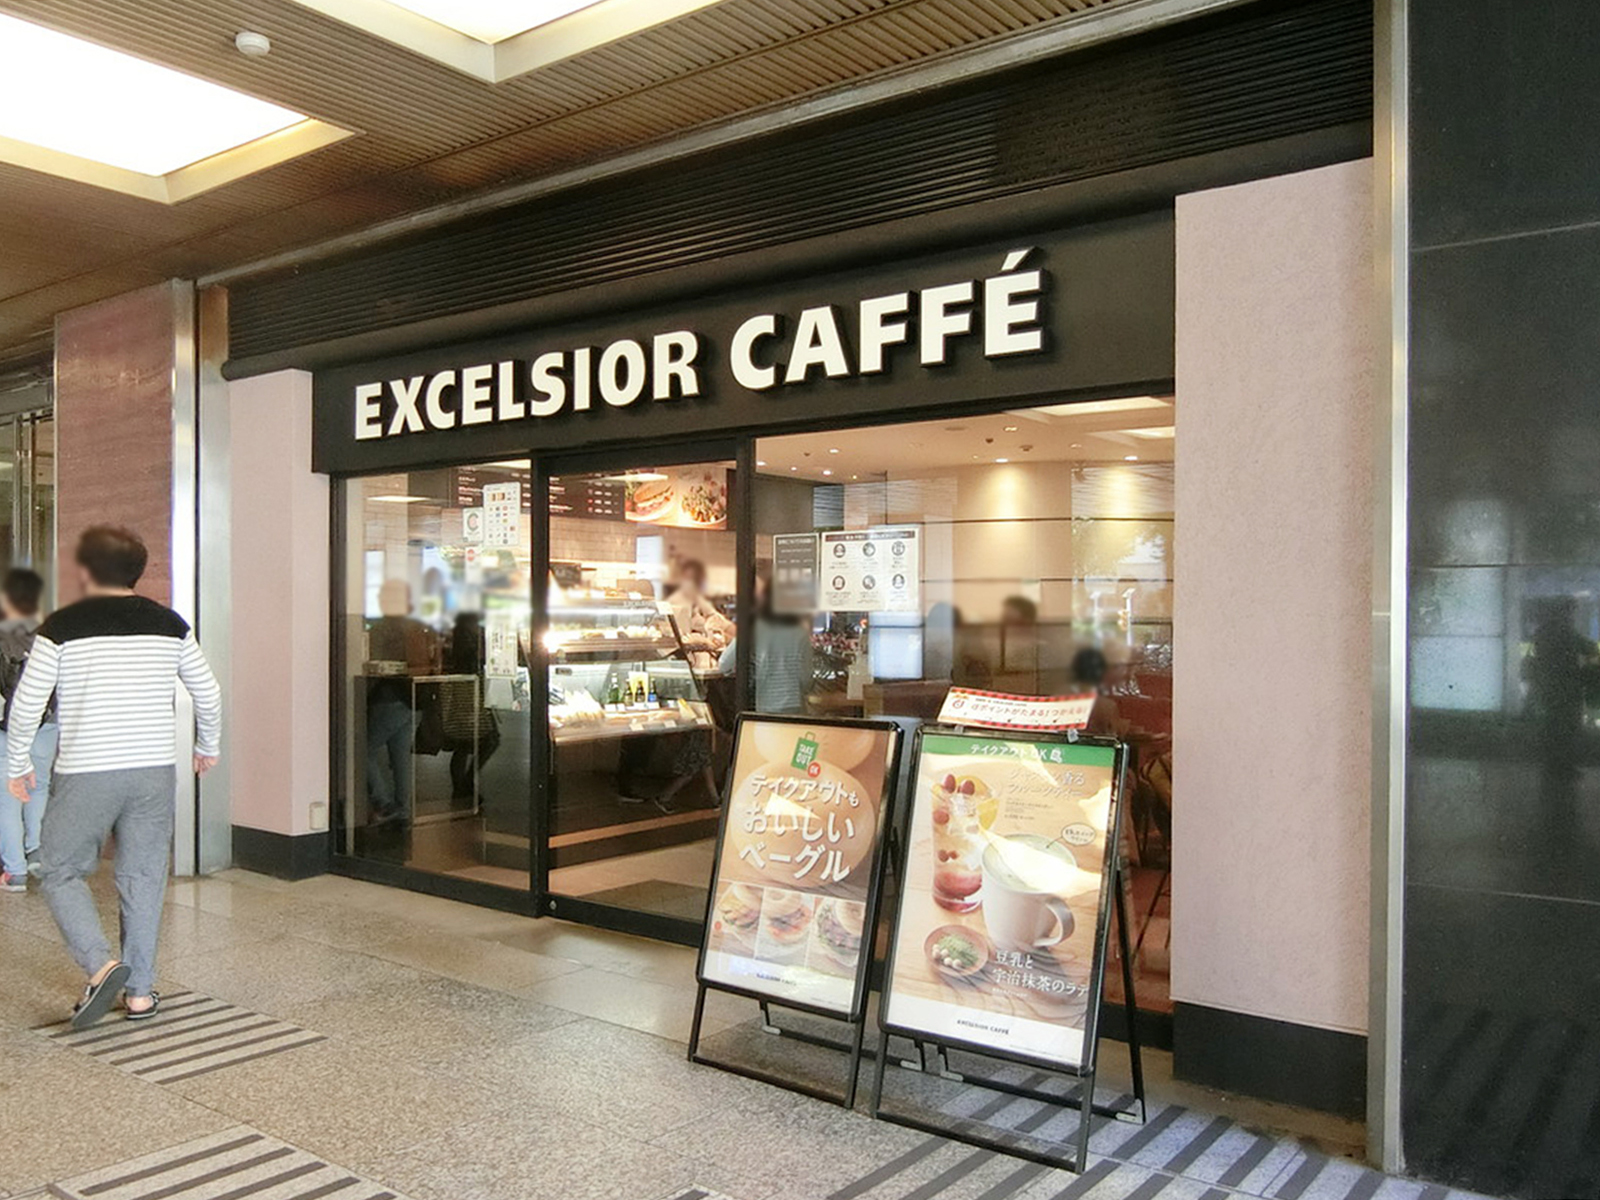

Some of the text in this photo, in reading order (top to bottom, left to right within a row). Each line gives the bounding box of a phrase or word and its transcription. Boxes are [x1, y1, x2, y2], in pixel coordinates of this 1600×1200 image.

[354, 246, 1045, 441] EXCELSIOR CAFFÉ
[795, 752, 812, 765] OUT
[751, 775, 860, 808] テイクアウトも
[744, 804, 855, 844] おいしい
[740, 843, 851, 882] ベーグル
[996, 950, 1034, 969] 豆乳と
